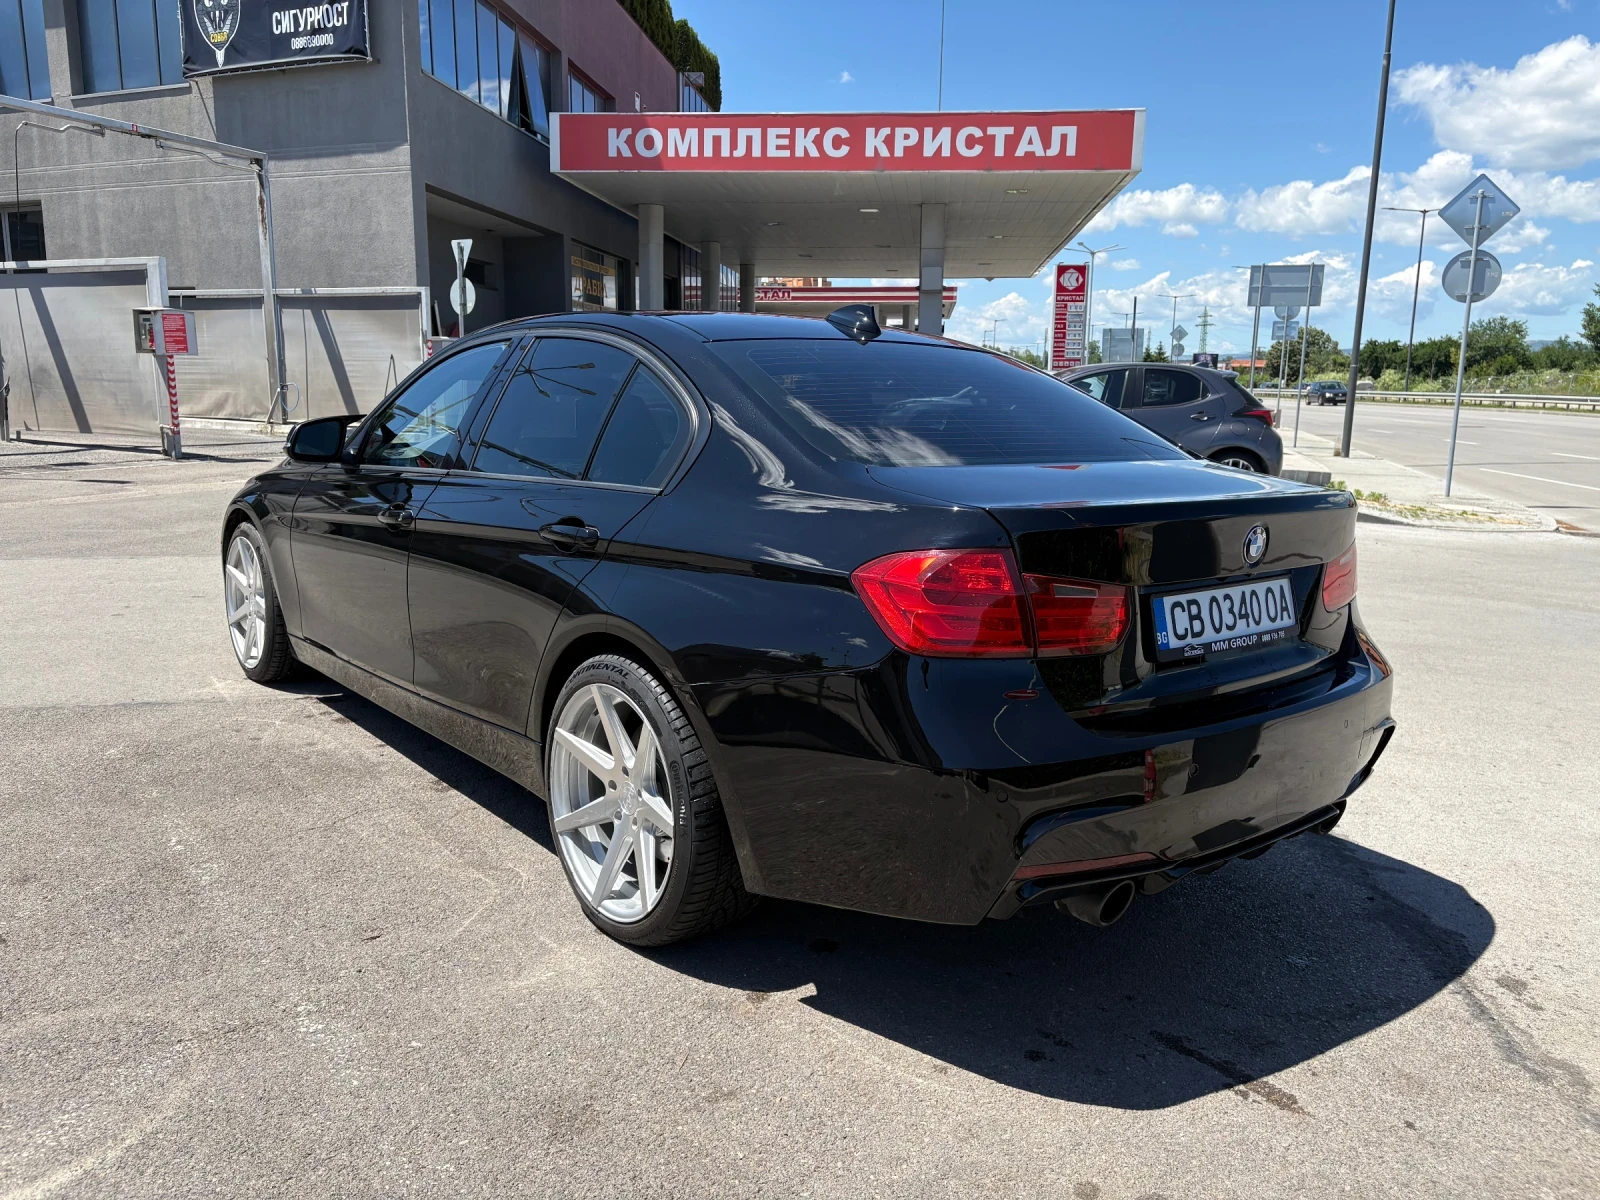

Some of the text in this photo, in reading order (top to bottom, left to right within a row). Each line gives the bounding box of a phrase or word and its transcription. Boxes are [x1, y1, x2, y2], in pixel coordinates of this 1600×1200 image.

[272, 2, 349, 35] СИГУРНОСТ
[607, 125, 1078, 158] КОМПЛЕКС КРИСТАЛ
[753, 289, 792, 300] СТАЛ
[1170, 584, 1292, 641] CB 0340 OA
[1157, 631, 1168, 645] BG
[1211, 640, 1229, 652] MM
[1230, 635, 1258, 648] GROUP
